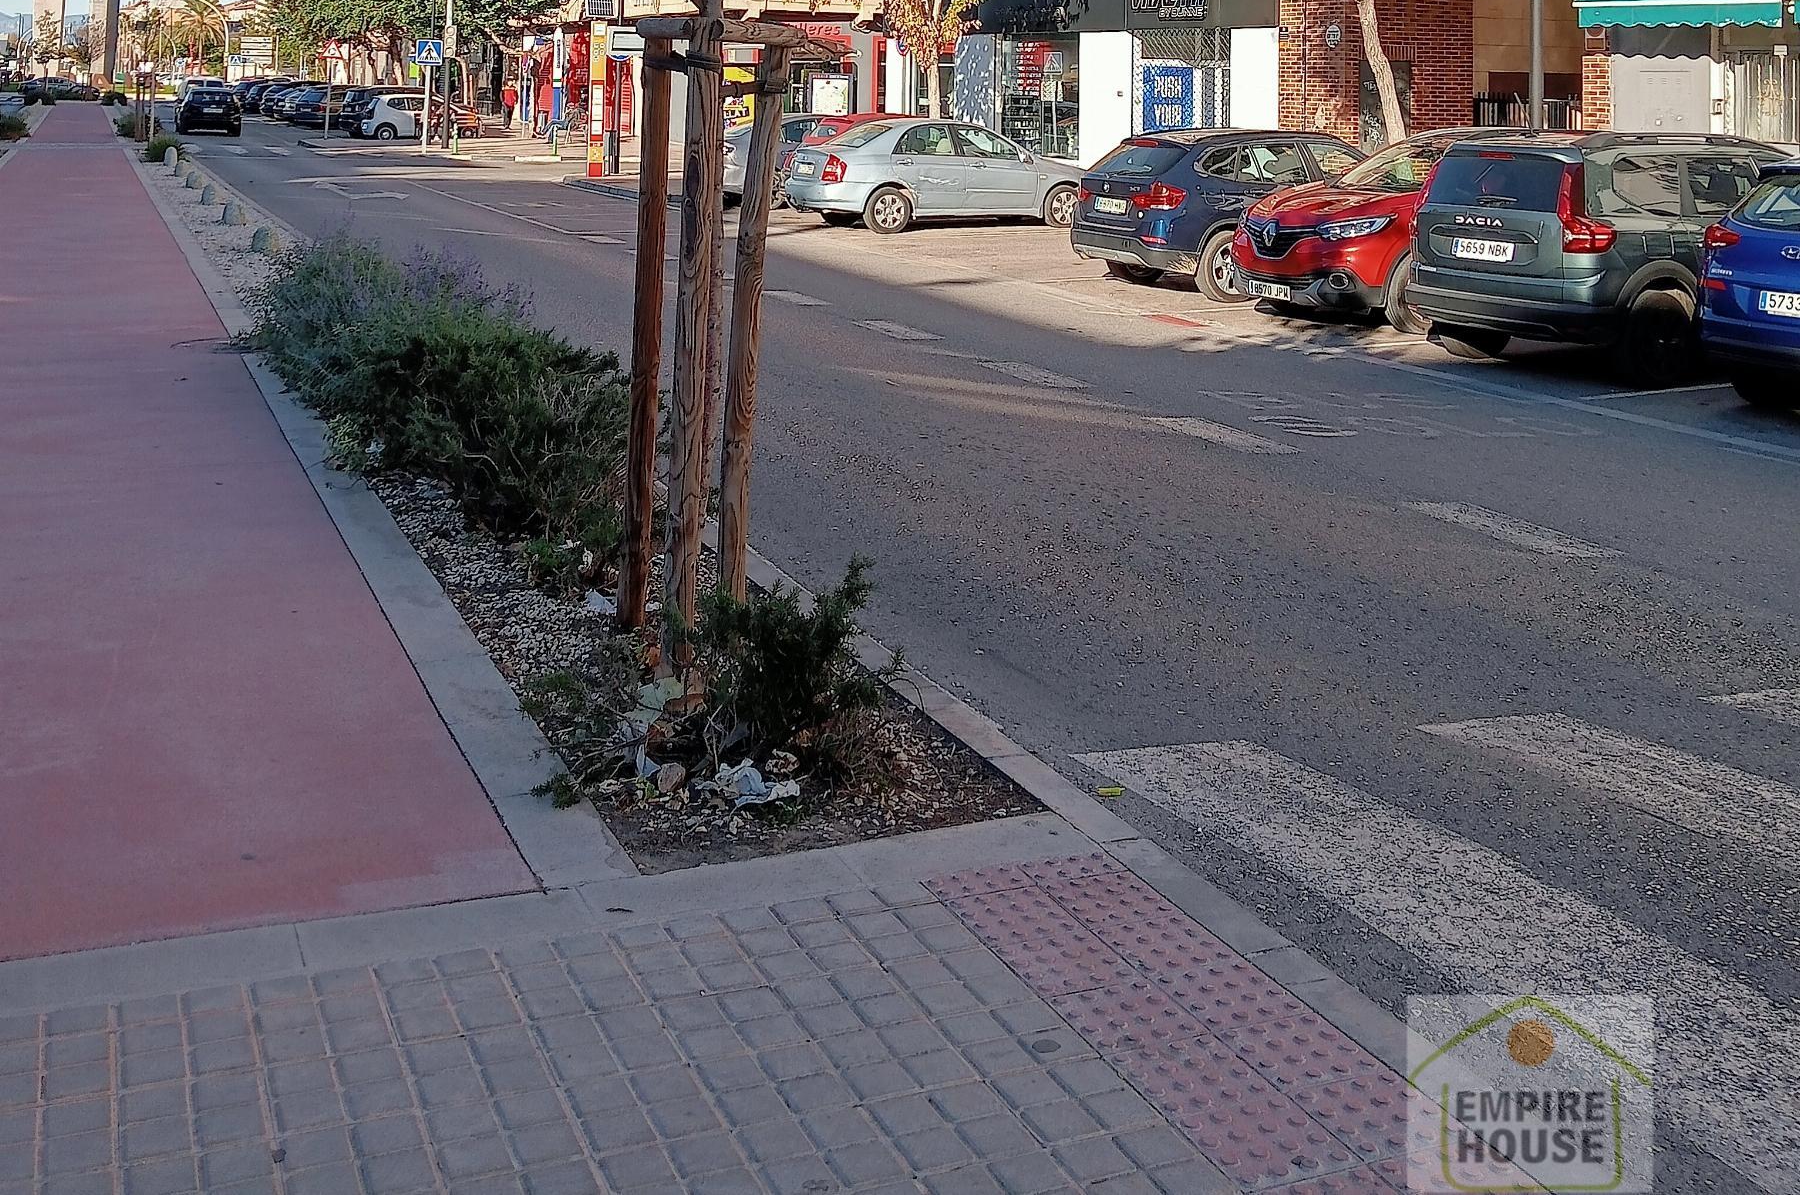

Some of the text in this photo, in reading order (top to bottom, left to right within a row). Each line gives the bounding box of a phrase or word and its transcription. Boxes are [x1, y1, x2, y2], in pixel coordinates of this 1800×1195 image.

[1154, 75, 1182, 98] PUSH
[1153, 103, 1182, 127] YOUR
[1455, 215, 1503, 227] DACIA
[1460, 240, 1508, 257] 5659 NBK
[1768, 293, 1800, 312] 5733
